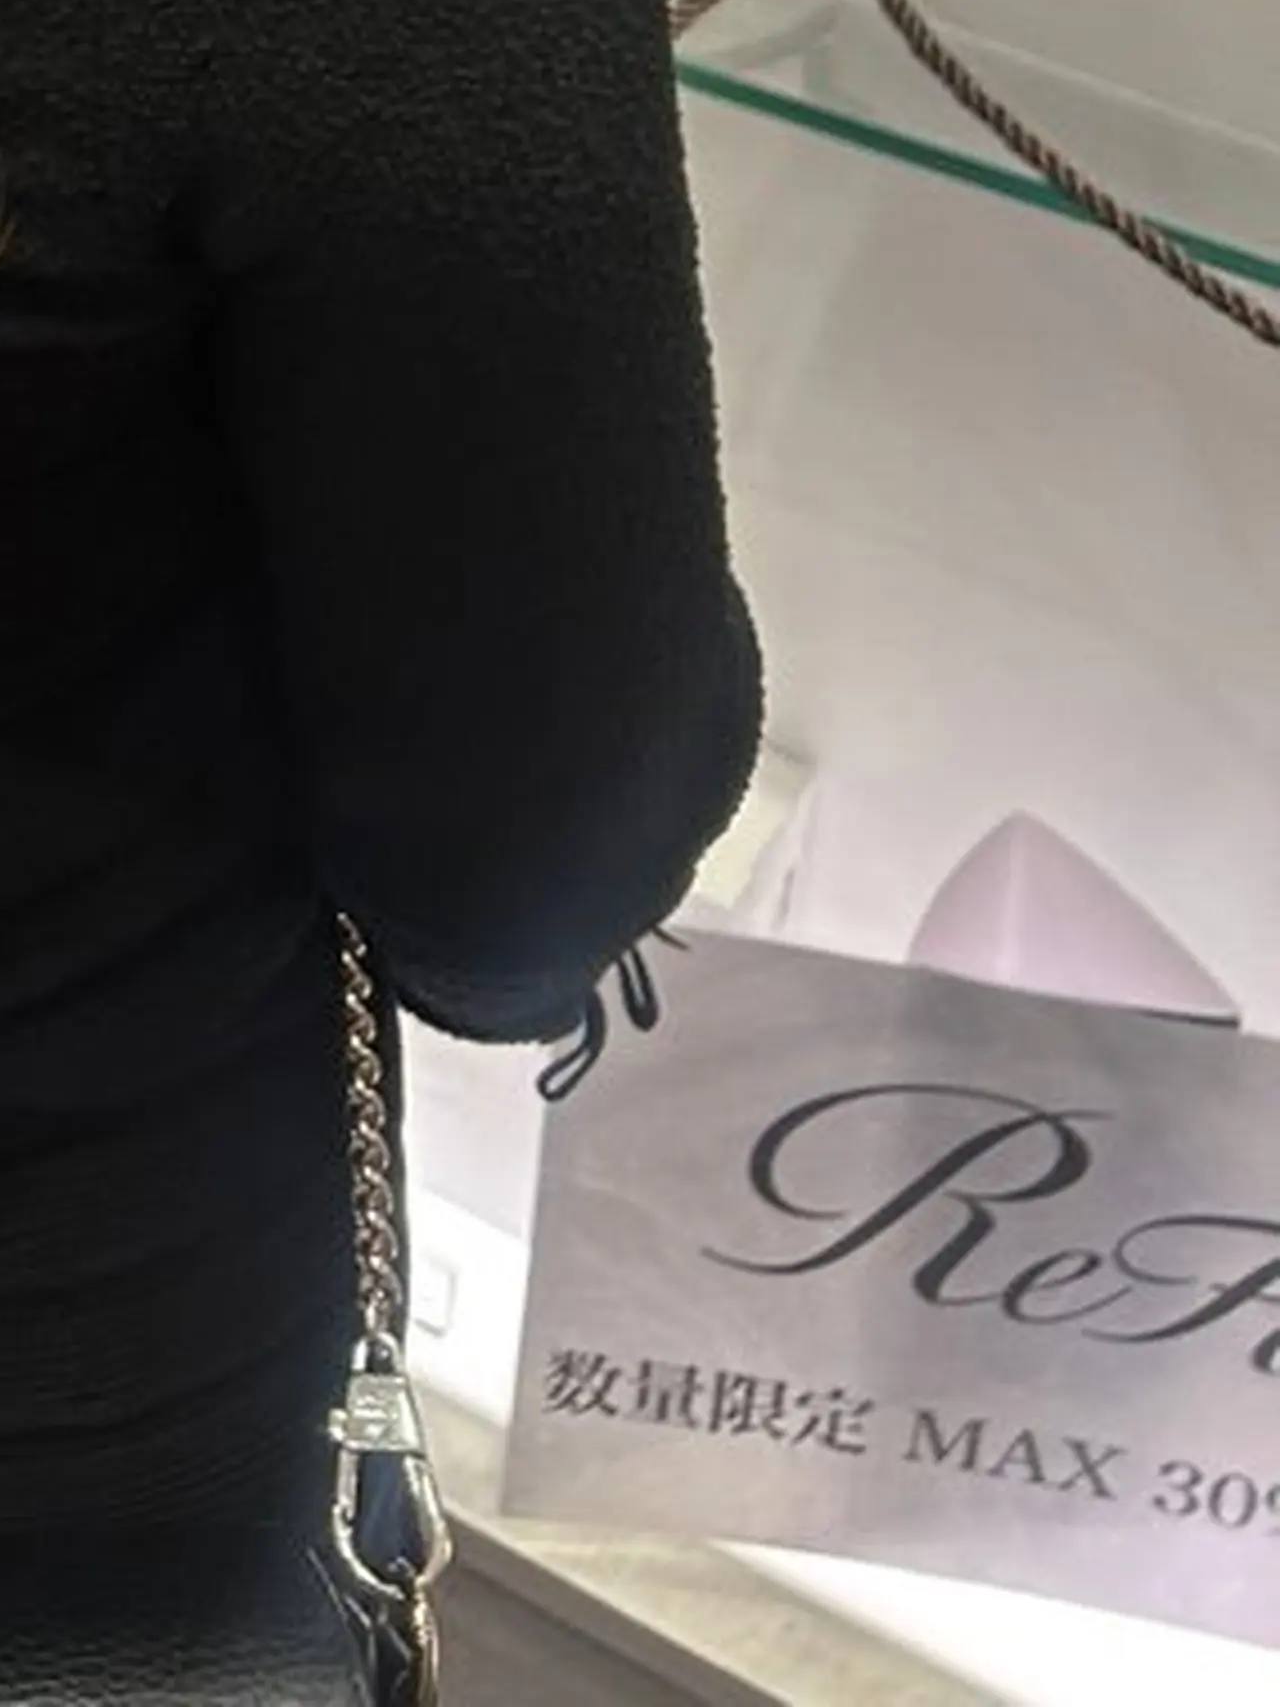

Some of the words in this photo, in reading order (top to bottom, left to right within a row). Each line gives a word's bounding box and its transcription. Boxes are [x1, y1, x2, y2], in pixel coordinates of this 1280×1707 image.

[542, 1347, 877, 1456] 数量限定
[903, 1408, 1130, 1500] MAX
